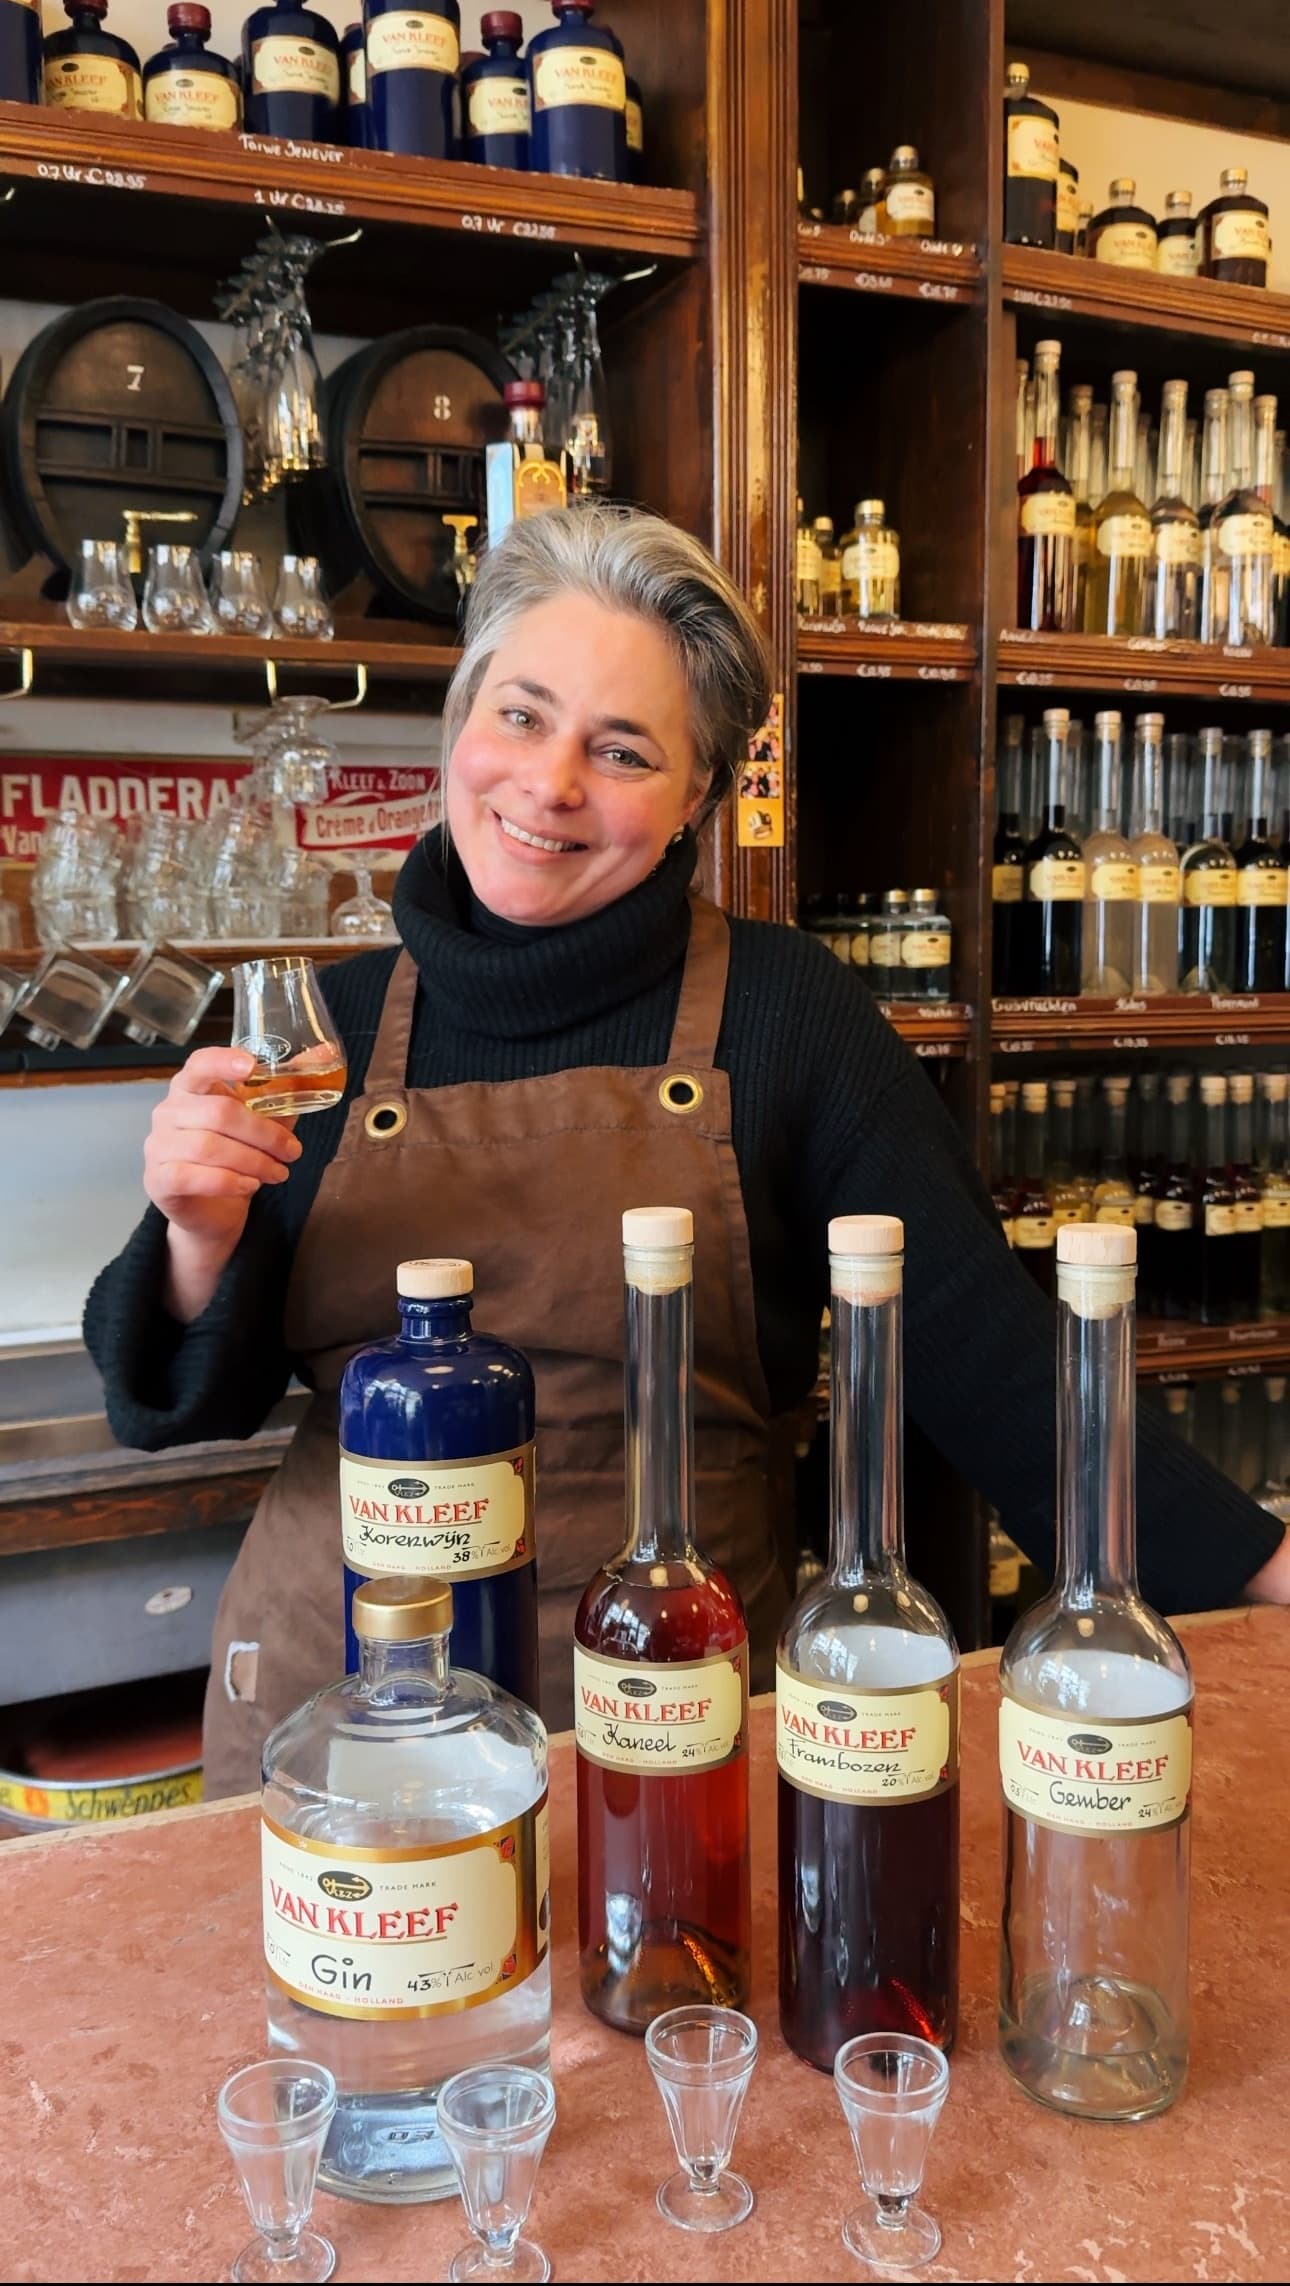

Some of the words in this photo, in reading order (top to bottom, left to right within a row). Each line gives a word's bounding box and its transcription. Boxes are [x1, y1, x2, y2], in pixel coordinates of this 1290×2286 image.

[127, 365, 145, 391] 7
[434, 395, 452, 421] 8
[1, 774, 248, 822] FLADDERA
[2, 824, 42, 856] Van
[349, 1495, 390, 1522] VAN
[394, 1498, 490, 1525] KLEEF
[581, 1686, 619, 1717] VAN
[624, 1698, 712, 1722] KLEEF
[602, 1723, 677, 1752] Kaneel
[781, 1704, 818, 1740] VAN
[824, 1727, 916, 1750] KLEEF
[787, 1738, 901, 1772] Frambozen
[1017, 1740, 1067, 1775] VAN
[1074, 1754, 1169, 1781] KLEEF
[65, 1782, 192, 1821] Schweppes
[1049, 1780, 1131, 1811] Gember
[379, 1884, 409, 1892] TRADE
[412, 1881, 437, 1889] MARK
[270, 1878, 320, 1929] VAN
[326, 1902, 459, 1940] KLEEF
[311, 1954, 372, 1991] Gin
[354, 1996, 404, 2005] HOLLAND
